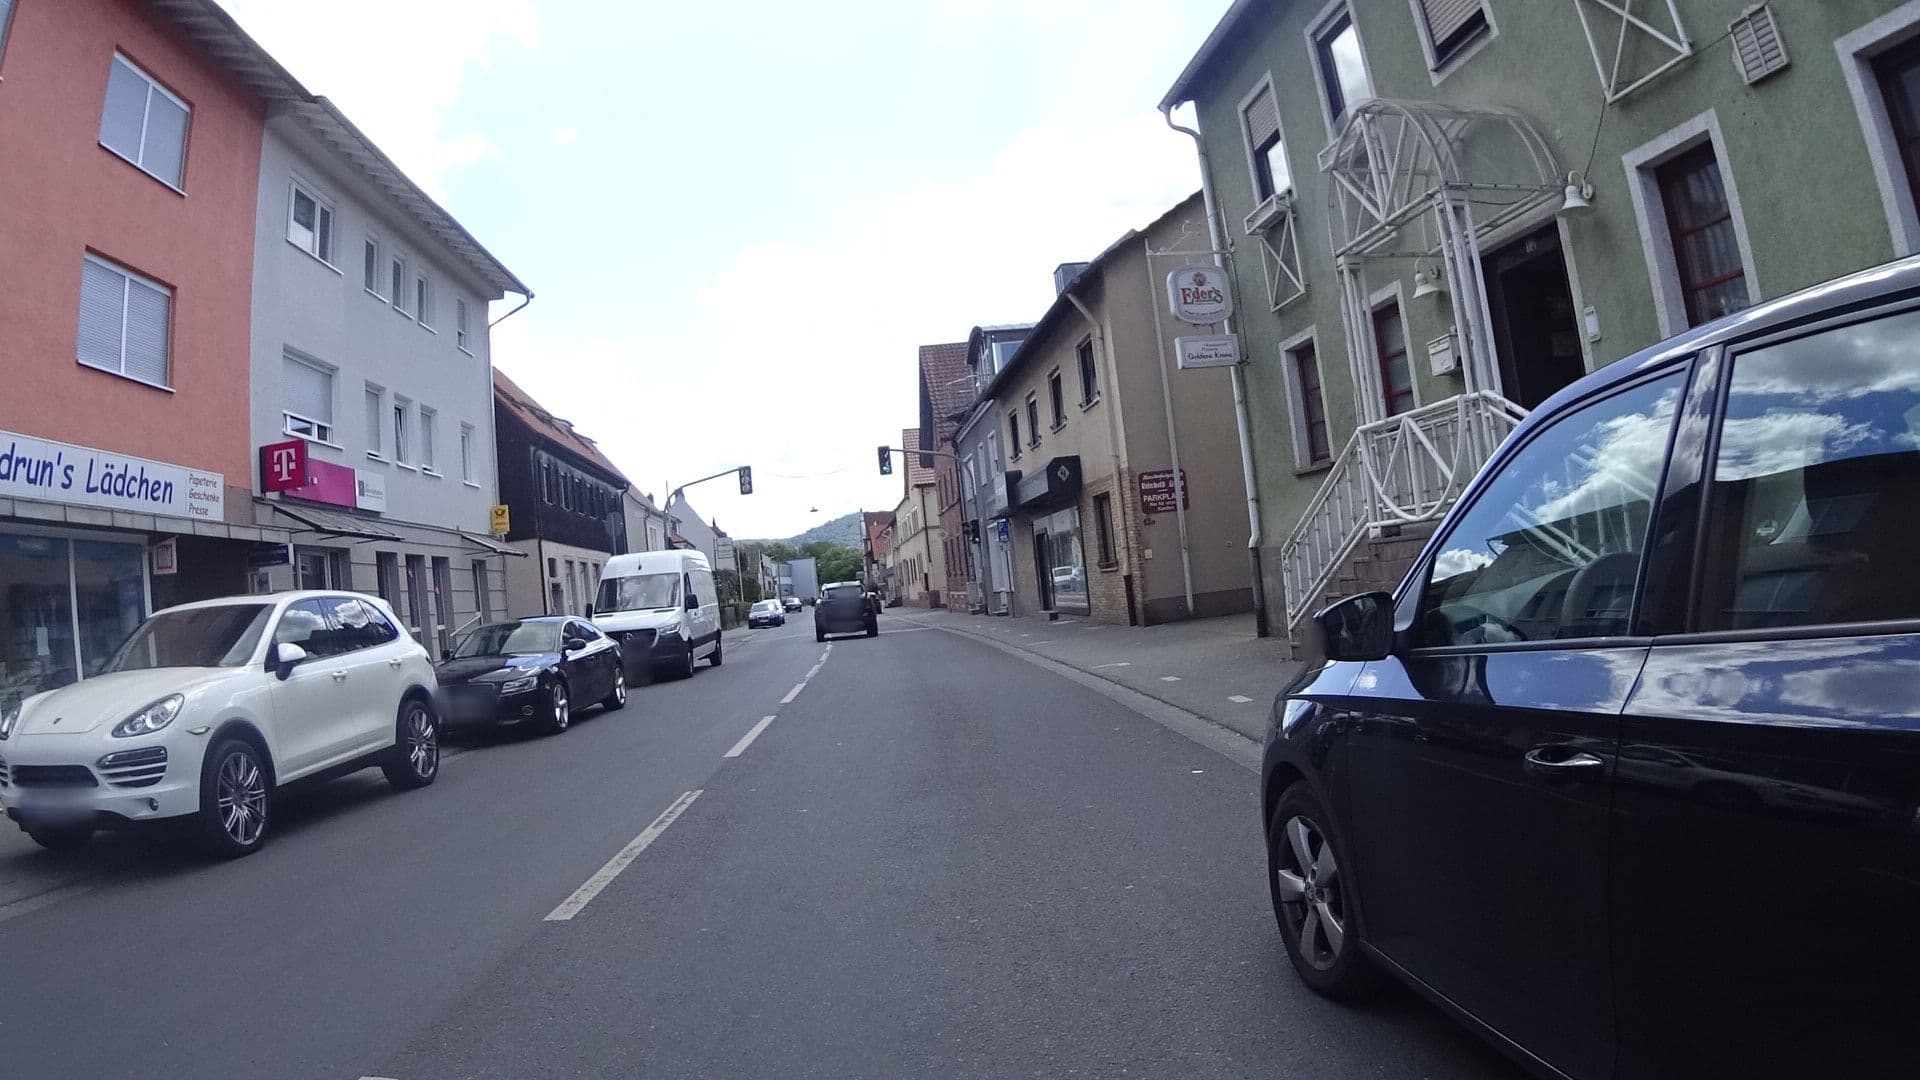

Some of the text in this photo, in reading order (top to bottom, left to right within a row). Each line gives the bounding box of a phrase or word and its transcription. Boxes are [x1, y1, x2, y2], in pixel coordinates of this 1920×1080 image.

[1181, 286, 1223, 305] Eder's
[273, 447, 296, 482] T
[86, 458, 173, 504] Lädchen
[188, 473, 218, 489] Papeterie
[188, 489, 220, 503] Geschenke
[1143, 492, 1185, 502] PARKPLAZ
[188, 502, 209, 516] Presse
